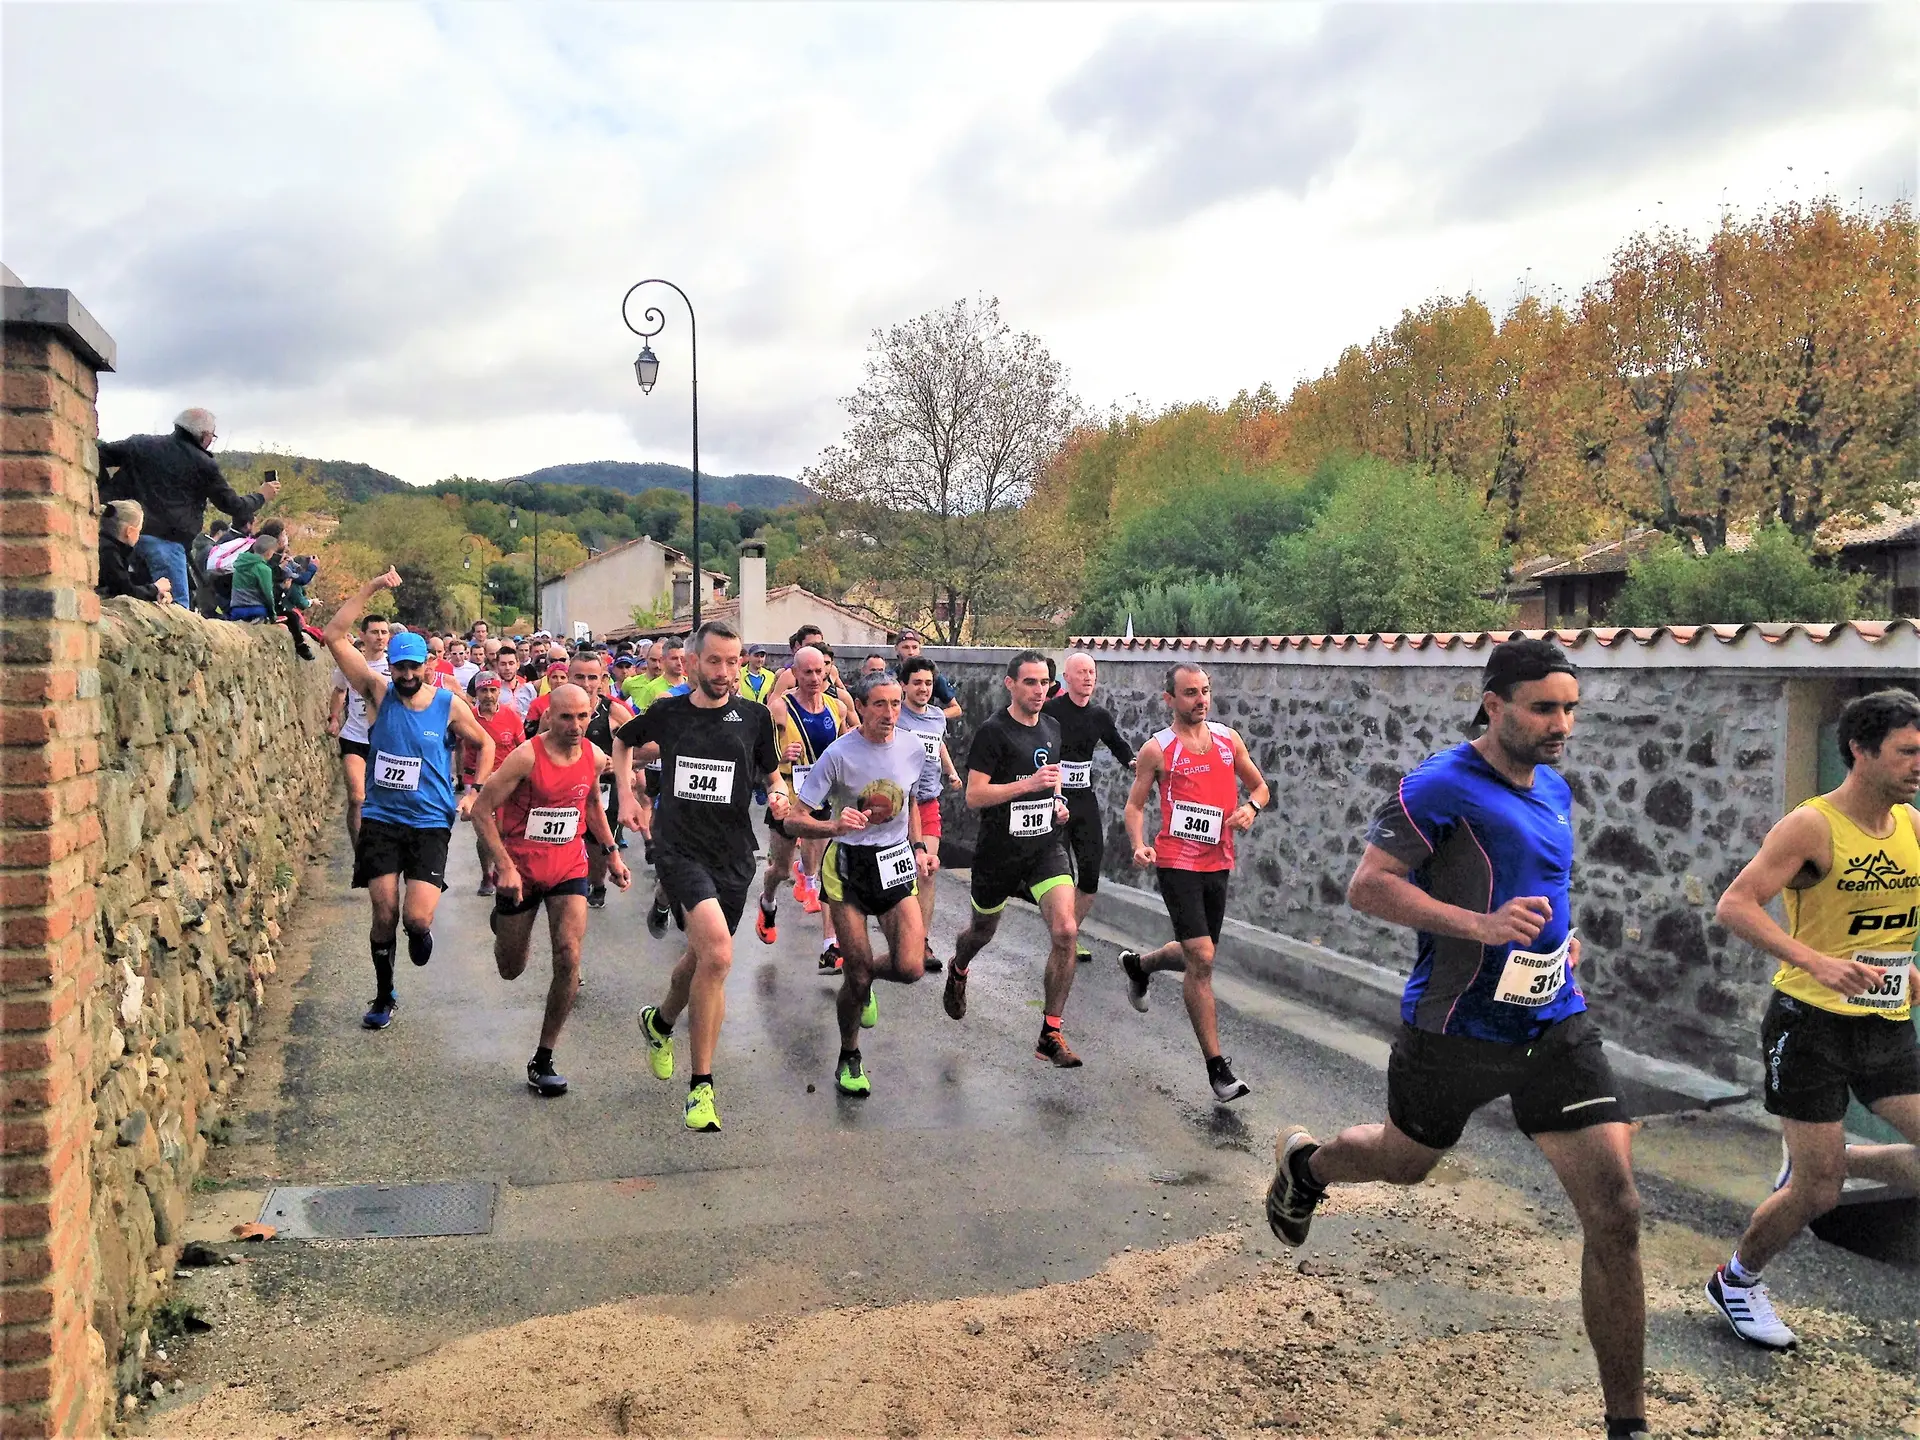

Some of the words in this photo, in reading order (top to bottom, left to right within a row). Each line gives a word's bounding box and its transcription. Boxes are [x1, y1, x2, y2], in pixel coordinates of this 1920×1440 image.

[384, 766, 406, 782] 272
[1068, 772, 1085, 782] 312
[1183, 764, 1211, 776] GARDE
[688, 774, 717, 792] 344
[543, 821, 566, 835] 317
[1022, 813, 1043, 828] 318
[1184, 816, 1210, 834] 340
[892, 857, 914, 875] 185
[1836, 878, 1880, 891] team
